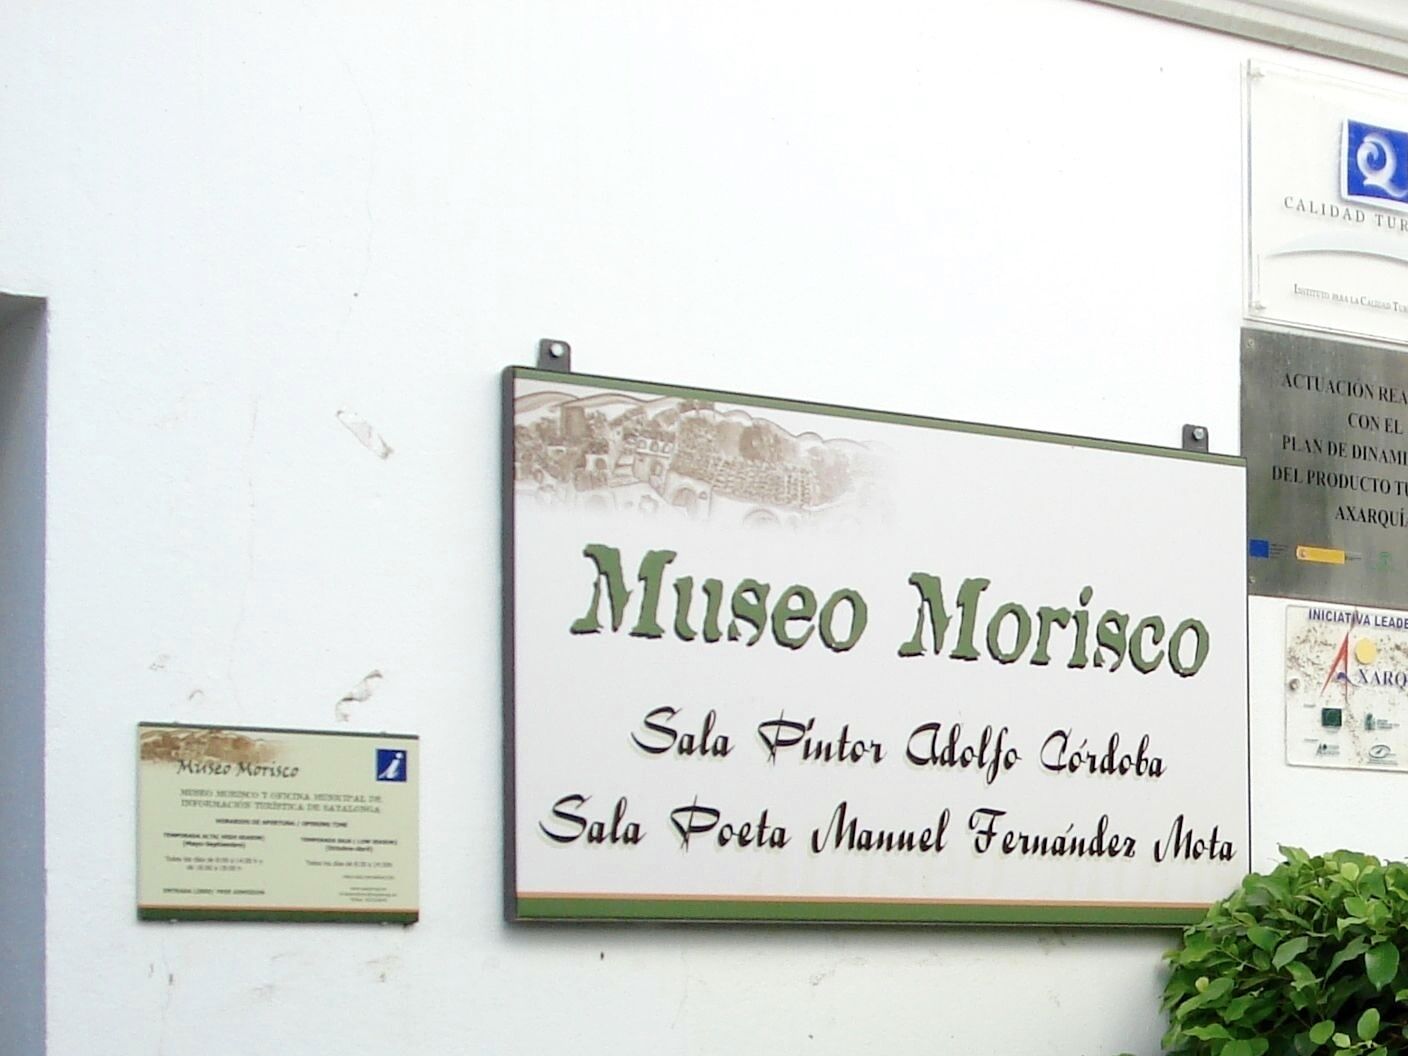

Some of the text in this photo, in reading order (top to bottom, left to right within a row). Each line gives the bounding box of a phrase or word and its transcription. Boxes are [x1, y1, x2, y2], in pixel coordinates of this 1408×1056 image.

[1284, 196, 1366, 224] CALIDAD
[1281, 372, 1374, 400] ACTUACIÓN
[1347, 412, 1404, 435] CON EL
[1281, 434, 1323, 455] PLAN
[1327, 440, 1348, 458] DE
[1272, 465, 1303, 484] DEL
[1307, 470, 1391, 495] PRODUCTO
[570, 543, 1211, 678] Museo Morisco
[1308, 608, 1371, 626] INICIATIVA
[630, 706, 1167, 786] Sala Pintor Adolfo Córdoba
[176, 758, 300, 778] Museo Morisco
[539, 794, 1239, 865] Sala Poeta Manuel Fernández Mota
